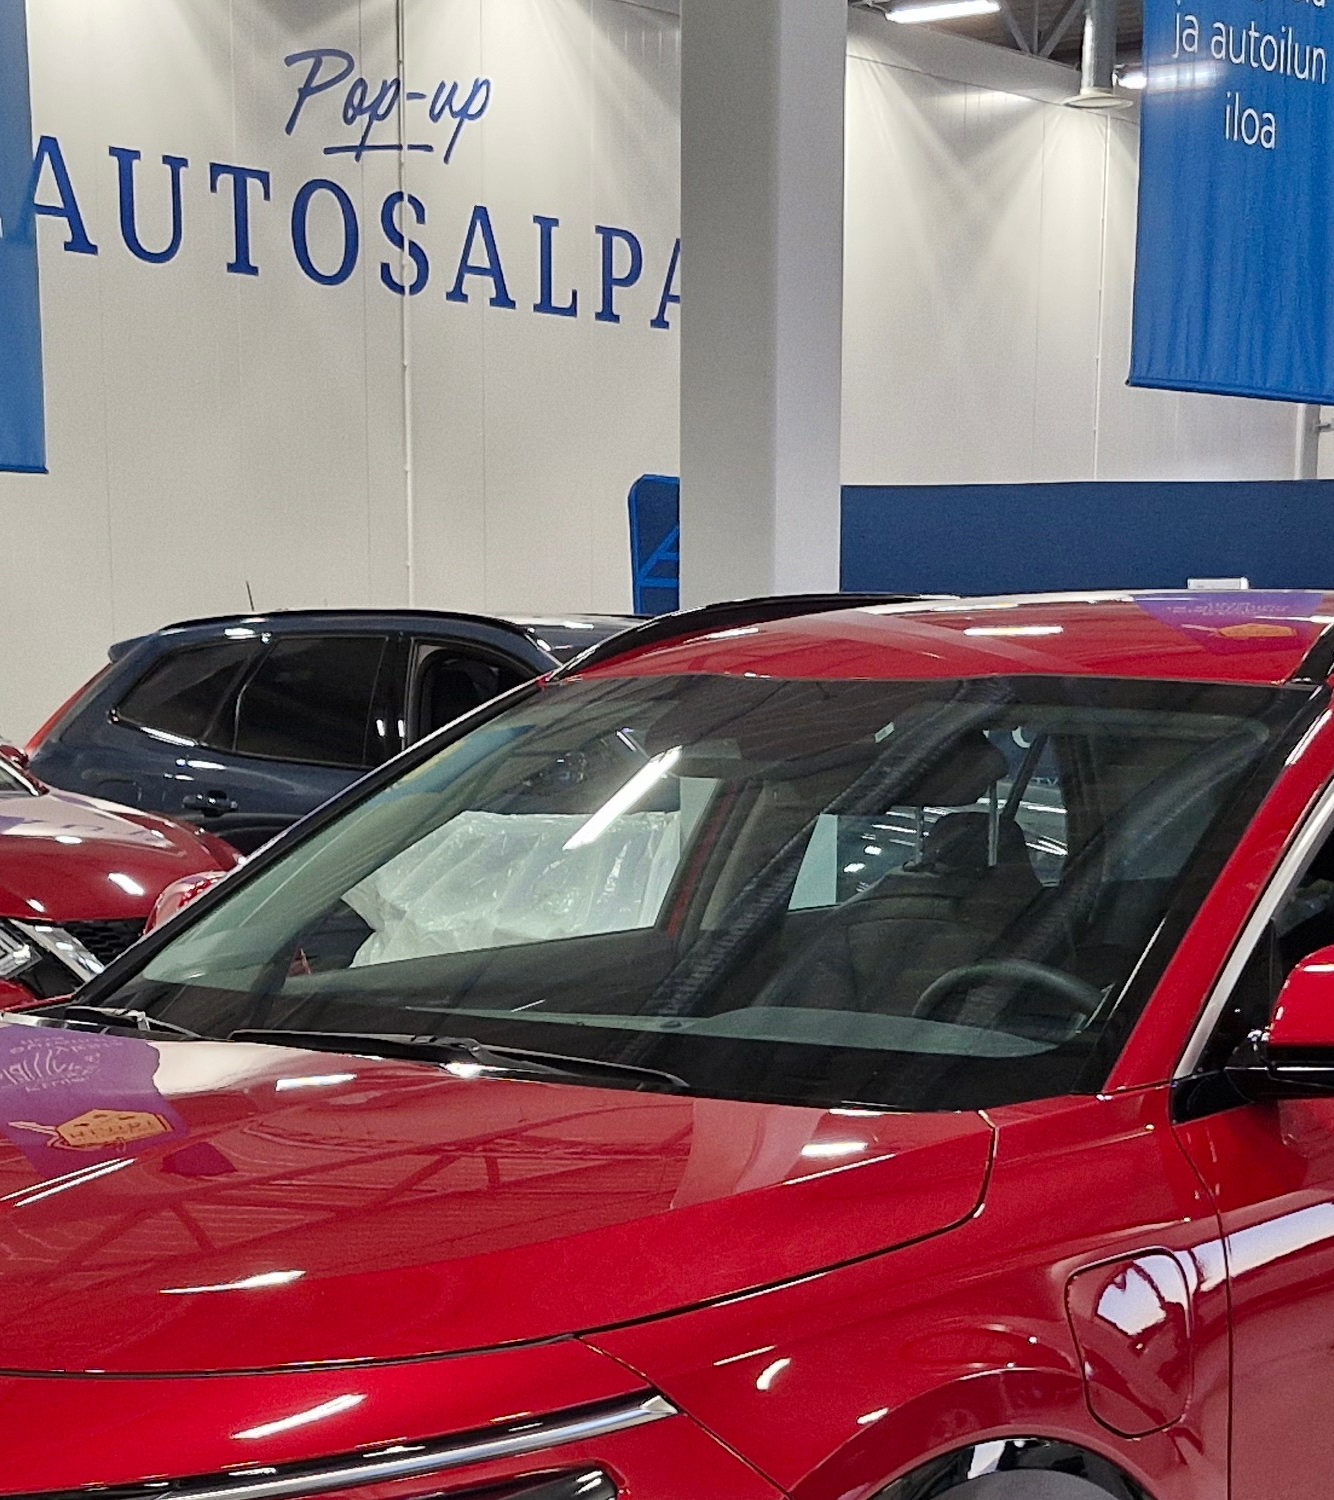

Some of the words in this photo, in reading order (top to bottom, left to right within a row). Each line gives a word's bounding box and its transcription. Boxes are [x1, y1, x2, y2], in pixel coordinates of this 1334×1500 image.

[1171, 0, 1200, 59] ja
[1211, 20, 1326, 85] autoilun
[284, 48, 492, 165] Pop-up
[1225, 91, 1276, 150] iloa
